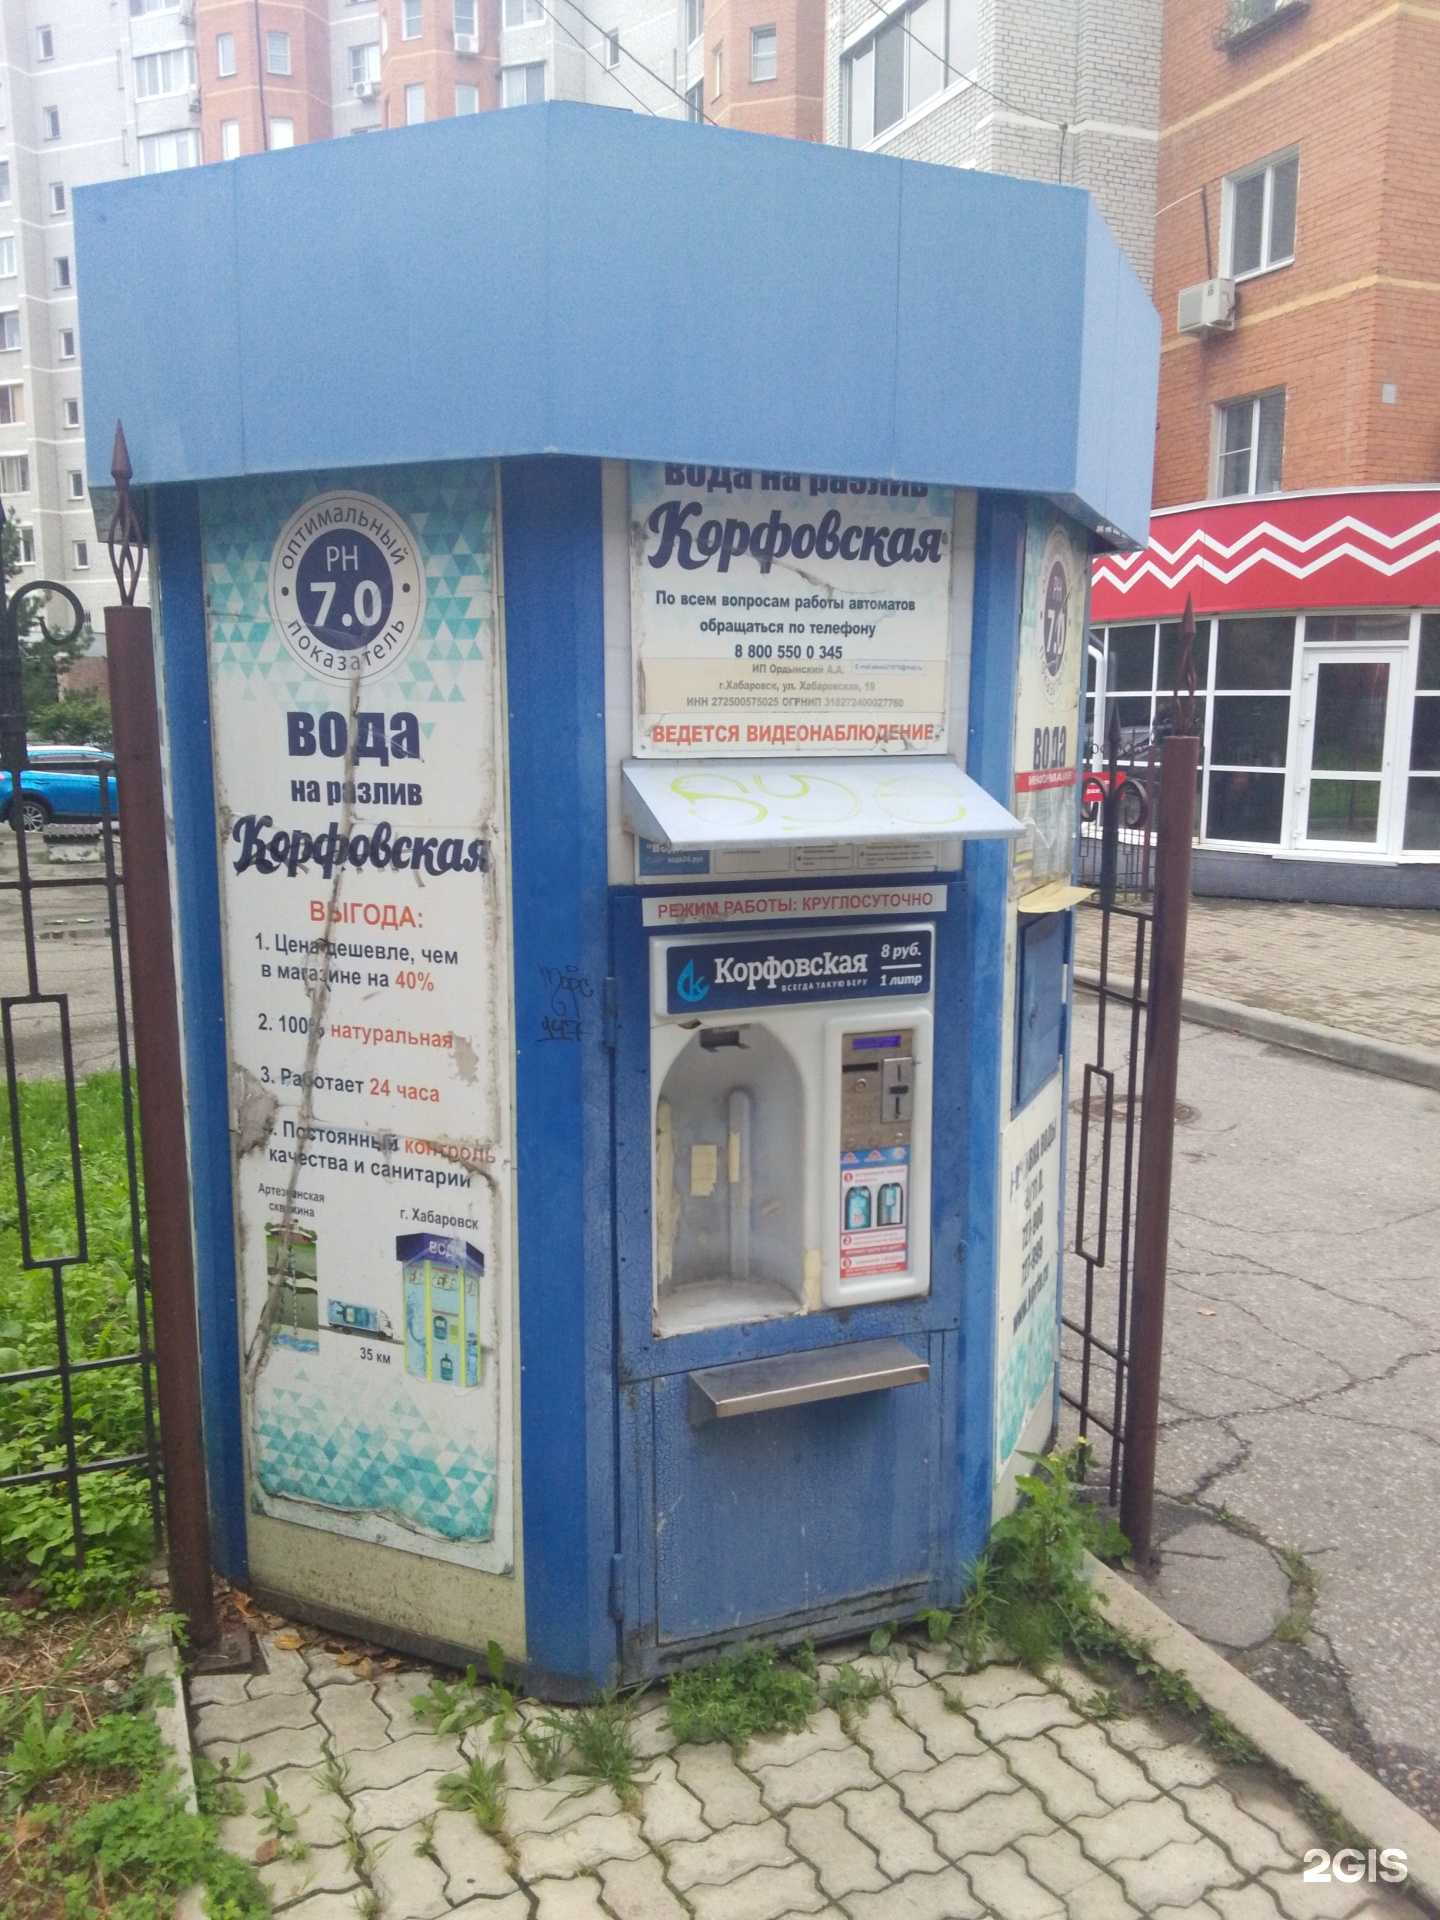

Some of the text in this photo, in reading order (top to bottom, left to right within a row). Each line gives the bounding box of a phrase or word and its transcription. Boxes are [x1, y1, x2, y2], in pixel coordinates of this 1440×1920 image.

[648, 500, 945, 574] Корфовская
[310, 579, 382, 627] 7.0
[655, 590, 916, 612] По всем вопросам работы автоматов
[700, 618, 876, 638] обращаться по телефону
[288, 620, 405, 671] показатель
[734, 644, 843, 660] 8 800 550 0 345
[752, 664, 767, 673] ИП
[686, 697, 708, 706] ИНН
[287, 711, 421, 767] вода
[652, 724, 934, 746] ВЕДЕТСЯ ВИДЕОНАБЛЮДЕНИЕ
[290, 780, 423, 806] на разлив
[232, 815, 491, 880] Корфовская
[309, 900, 424, 930] ВЫГОДА:
[658, 893, 934, 919] РЕЖИМ РАБОТЫ: КРУГЛОСУТОЧНО
[255, 933, 459, 965] 1. Цена дешевле, чем
[880, 941, 922, 960] 8 руб.
[261, 964, 272, 978] в
[368, 972, 390, 988] на
[395, 971, 435, 992] 40%
[714, 952, 868, 990] Корфовская
[879, 974, 923, 987] 1 литр
[258, 1013, 273, 1031] 2.
[331, 1023, 454, 1050] натуральная
[260, 1065, 275, 1084] 3.
[369, 1077, 391, 1097] 24
[396, 1086, 440, 1103] часа
[269, 1149, 471, 1189] качества и санитарии
[268, 1202, 316, 1218] сквжина
[399, 1207, 480, 1231] г. Хабаровск
[359, 1347, 391, 1364] 35 км
